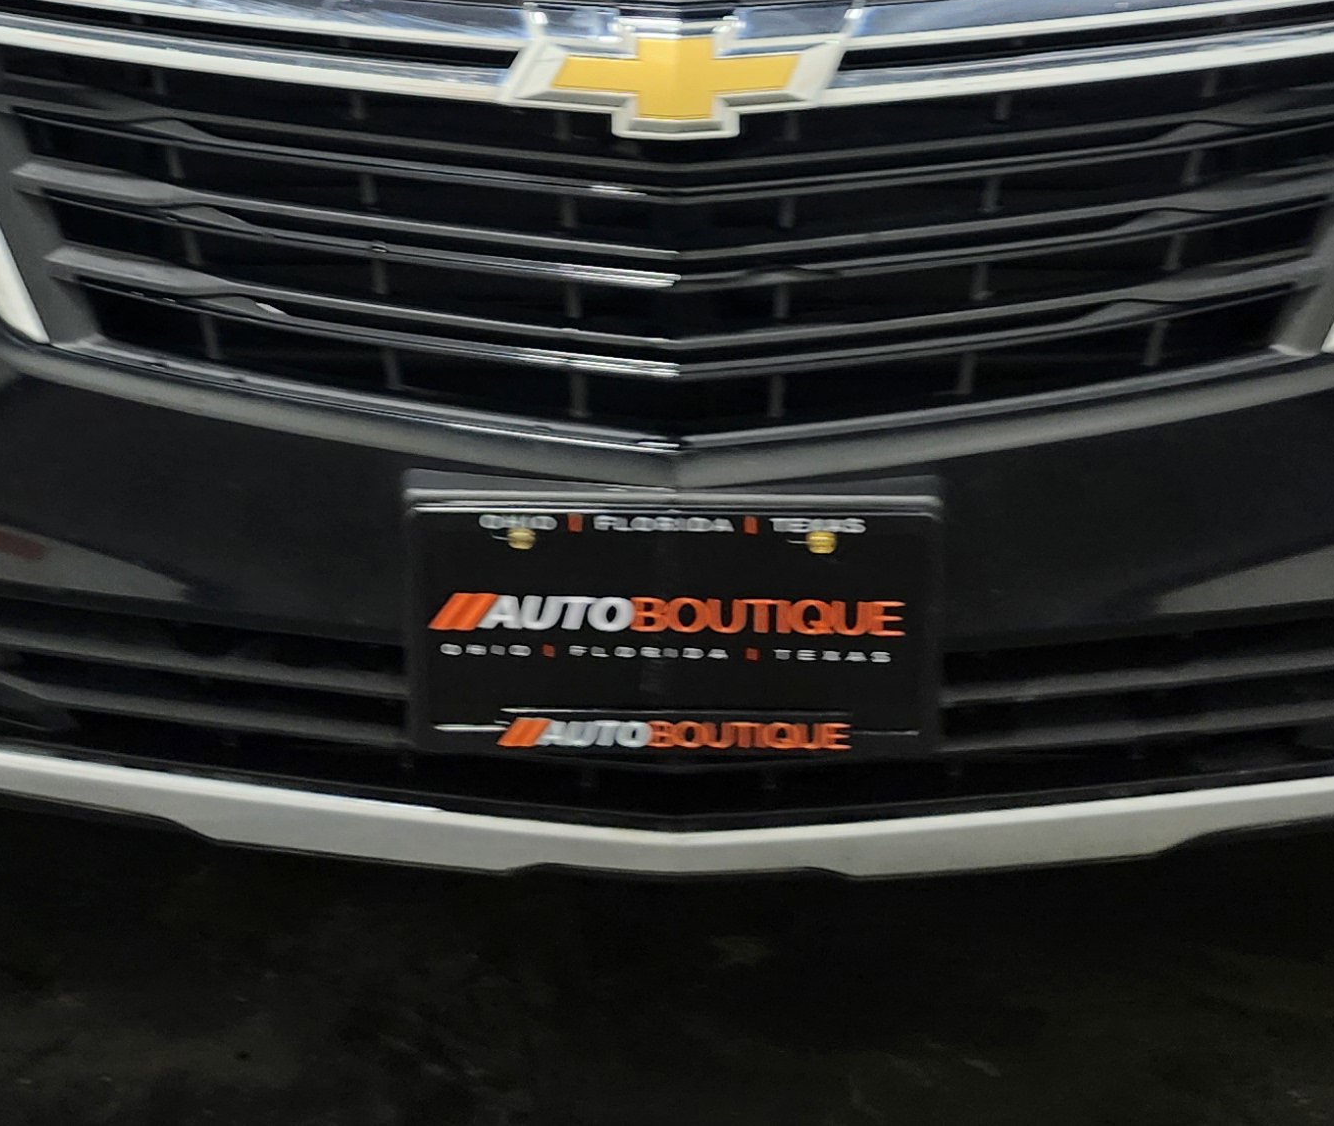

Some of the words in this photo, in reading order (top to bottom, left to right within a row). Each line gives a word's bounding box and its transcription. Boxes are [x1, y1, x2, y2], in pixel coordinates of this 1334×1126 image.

[593, 515, 735, 532] FLORIDA
[476, 595, 906, 637] AUTOBOUTIQUE
[568, 644, 729, 659] FLORIDA
[773, 648, 892, 663] TEXAS
[536, 720, 852, 750] AUTOBOUTIQUE
